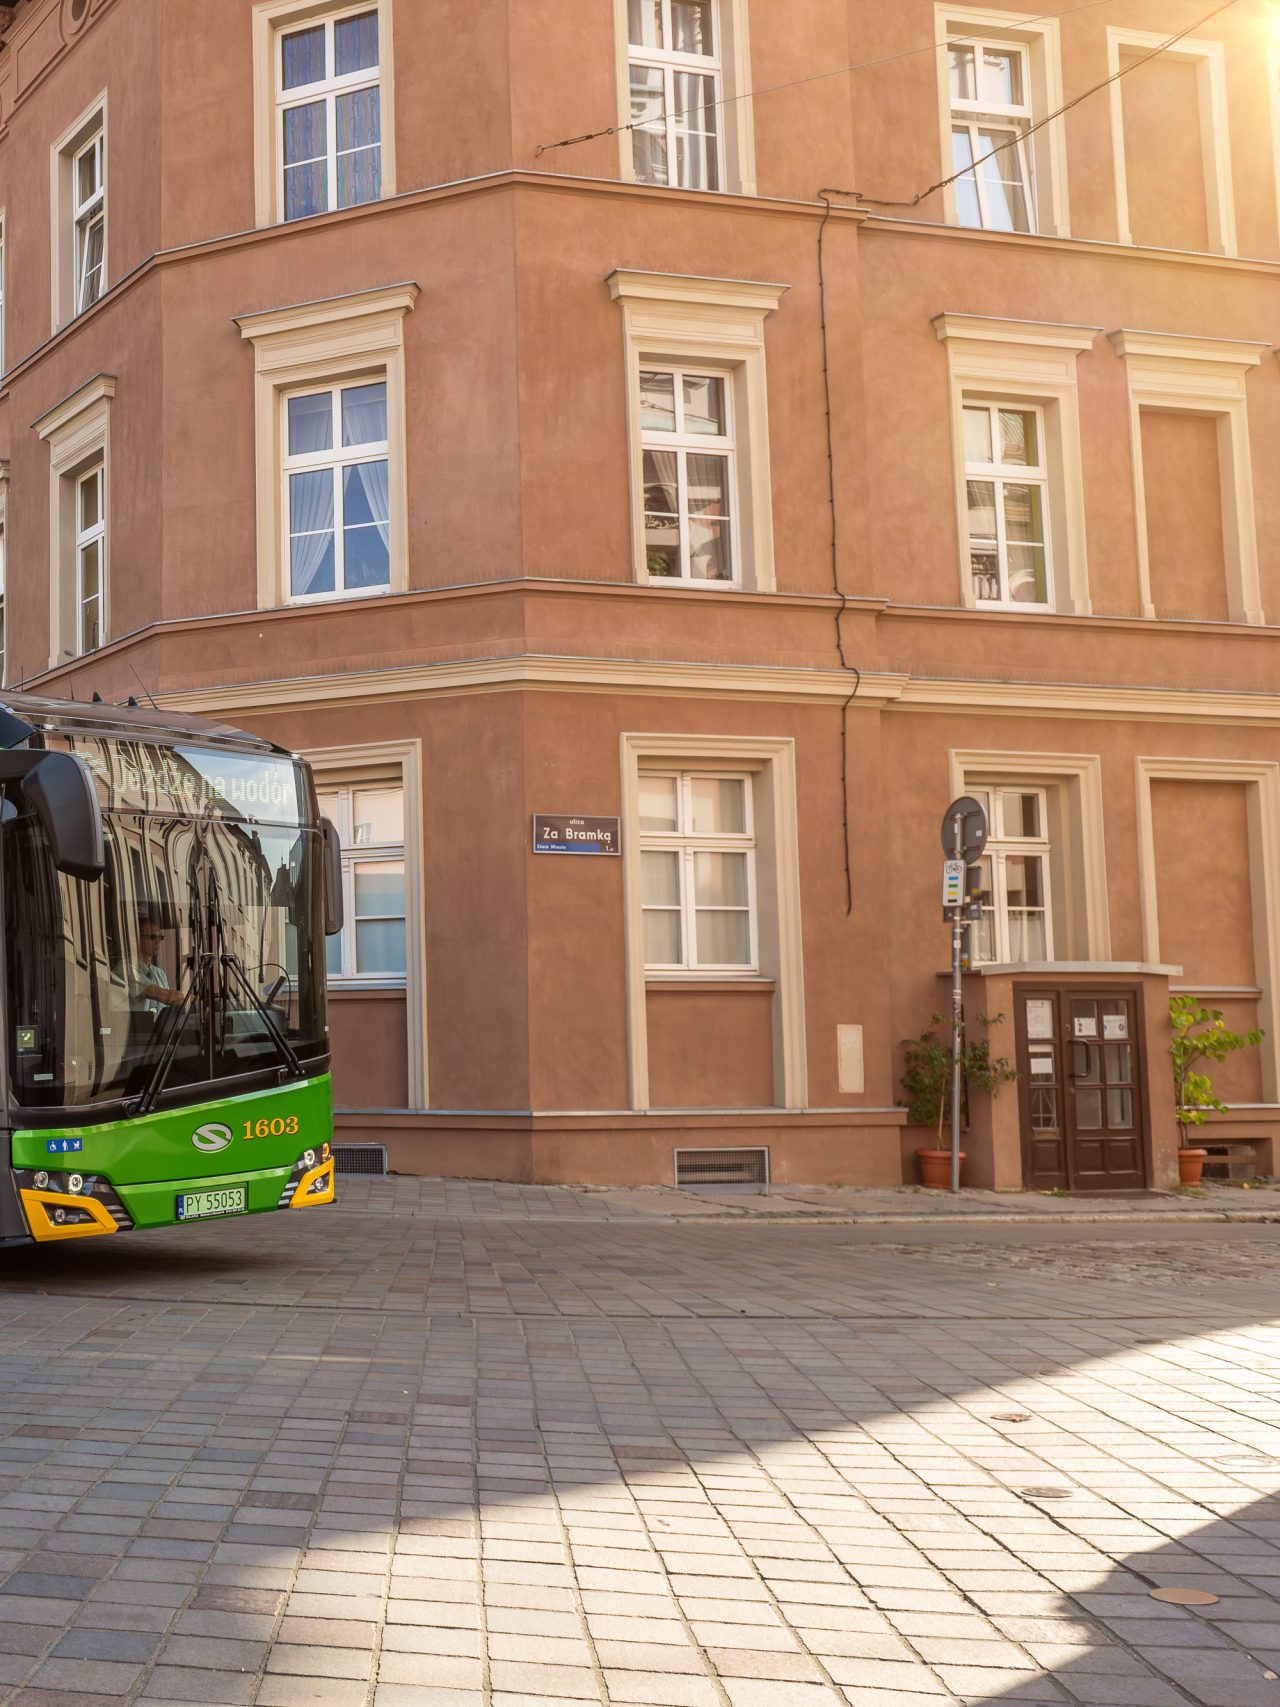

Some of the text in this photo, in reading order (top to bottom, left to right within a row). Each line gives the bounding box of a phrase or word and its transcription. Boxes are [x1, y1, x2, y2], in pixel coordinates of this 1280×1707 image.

[202, 775, 227, 799] na
[231, 770, 290, 805] wodór
[543, 827, 611, 844] Za Bramką
[242, 1116, 299, 1140] 1603
[186, 1190, 242, 1213] PY 55053
